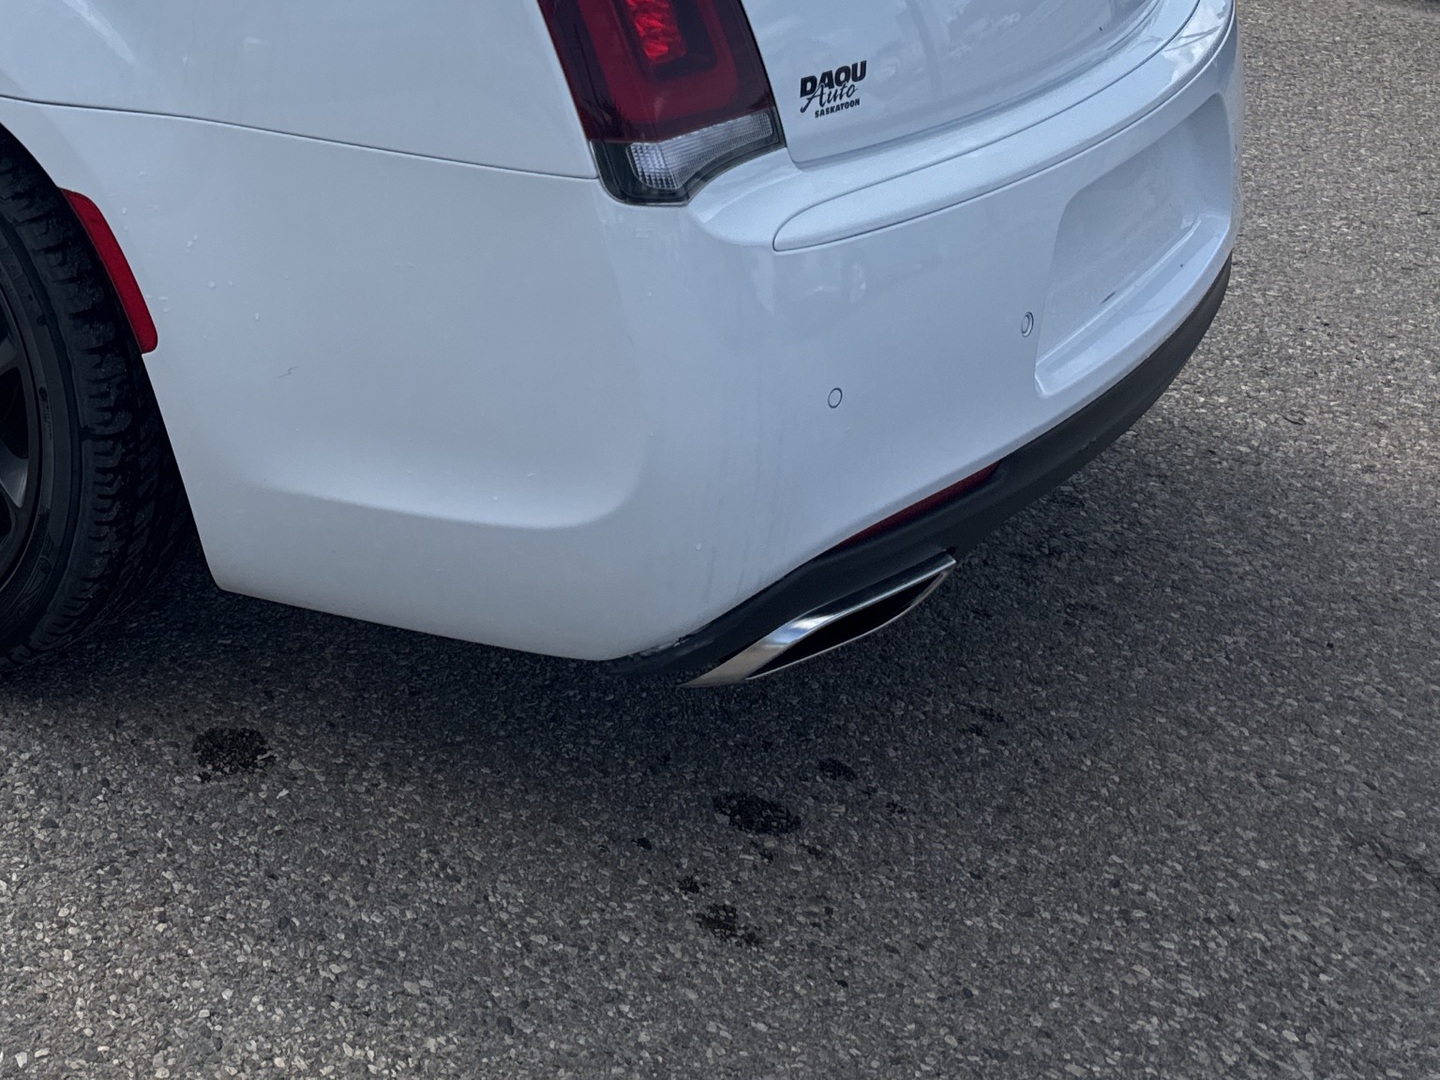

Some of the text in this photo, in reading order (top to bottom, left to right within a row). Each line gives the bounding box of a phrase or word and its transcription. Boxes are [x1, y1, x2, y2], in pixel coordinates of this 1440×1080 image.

[800, 60, 867, 98] DAOU
[800, 83, 858, 113] Auto
[814, 98, 860, 118] SASKATOON
